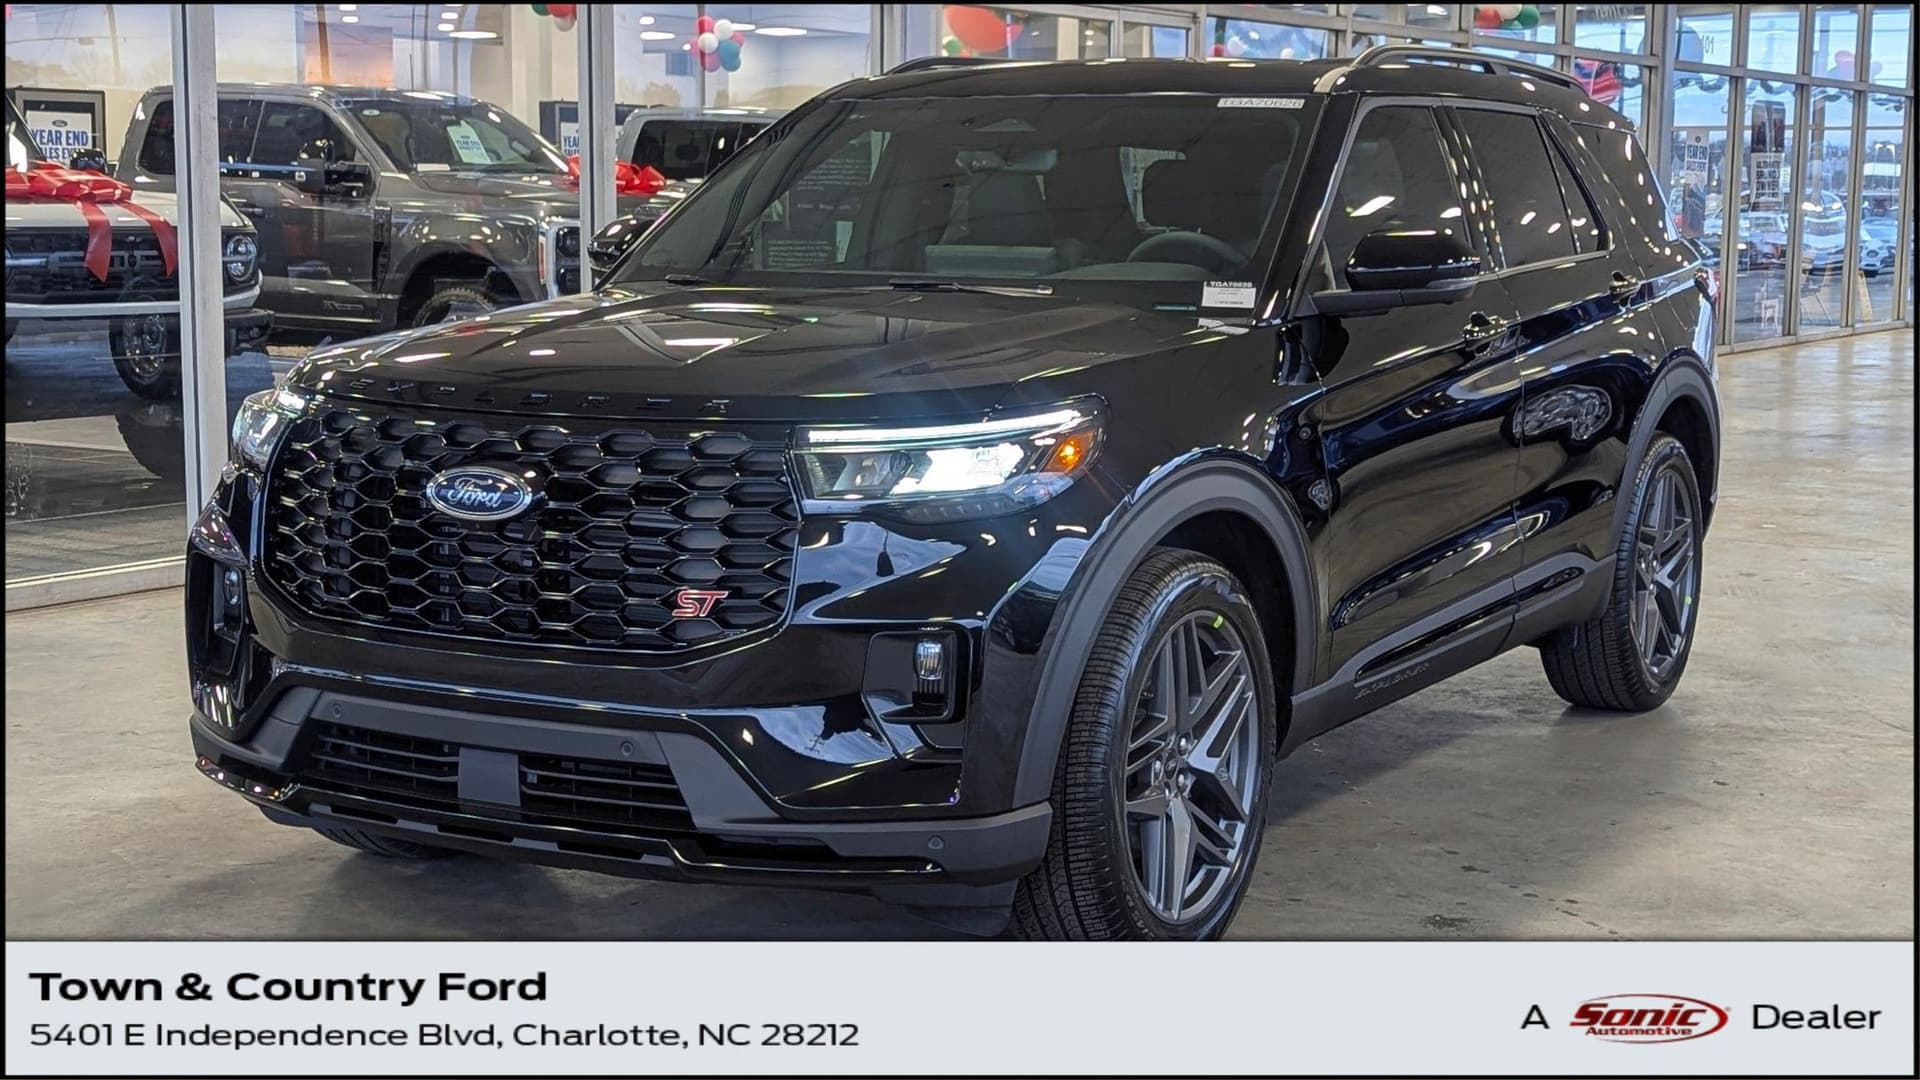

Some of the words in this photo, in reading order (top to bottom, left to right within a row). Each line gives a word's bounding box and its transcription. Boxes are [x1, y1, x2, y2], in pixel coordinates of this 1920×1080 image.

[32, 128, 62, 146] YEAR
[65, 130, 88, 146] END
[447, 477, 502, 507] Ford
[672, 590, 729, 617] ST
